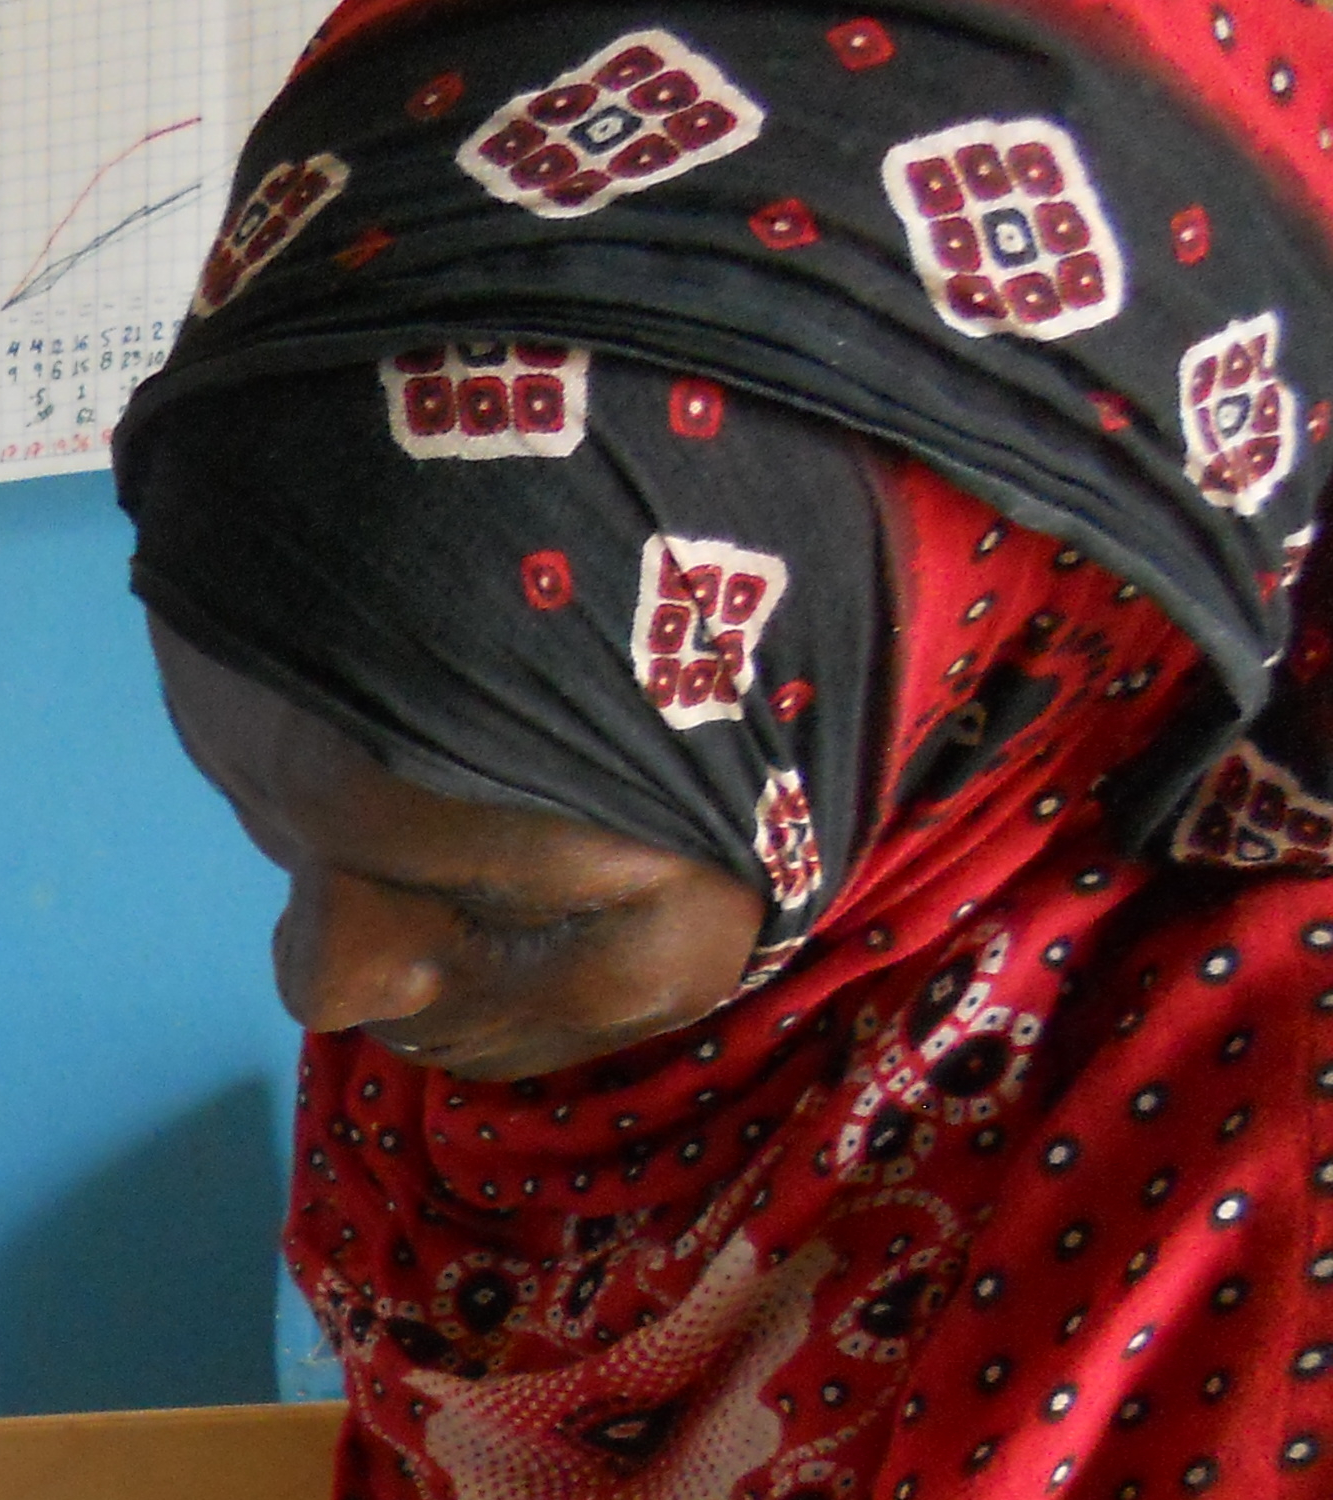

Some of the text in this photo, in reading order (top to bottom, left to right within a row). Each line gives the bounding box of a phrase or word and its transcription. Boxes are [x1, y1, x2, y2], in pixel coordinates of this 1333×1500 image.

[152, 321, 164, 341] 2
[51, 360, 63, 380] 6
[100, 351, 113, 371] 8
